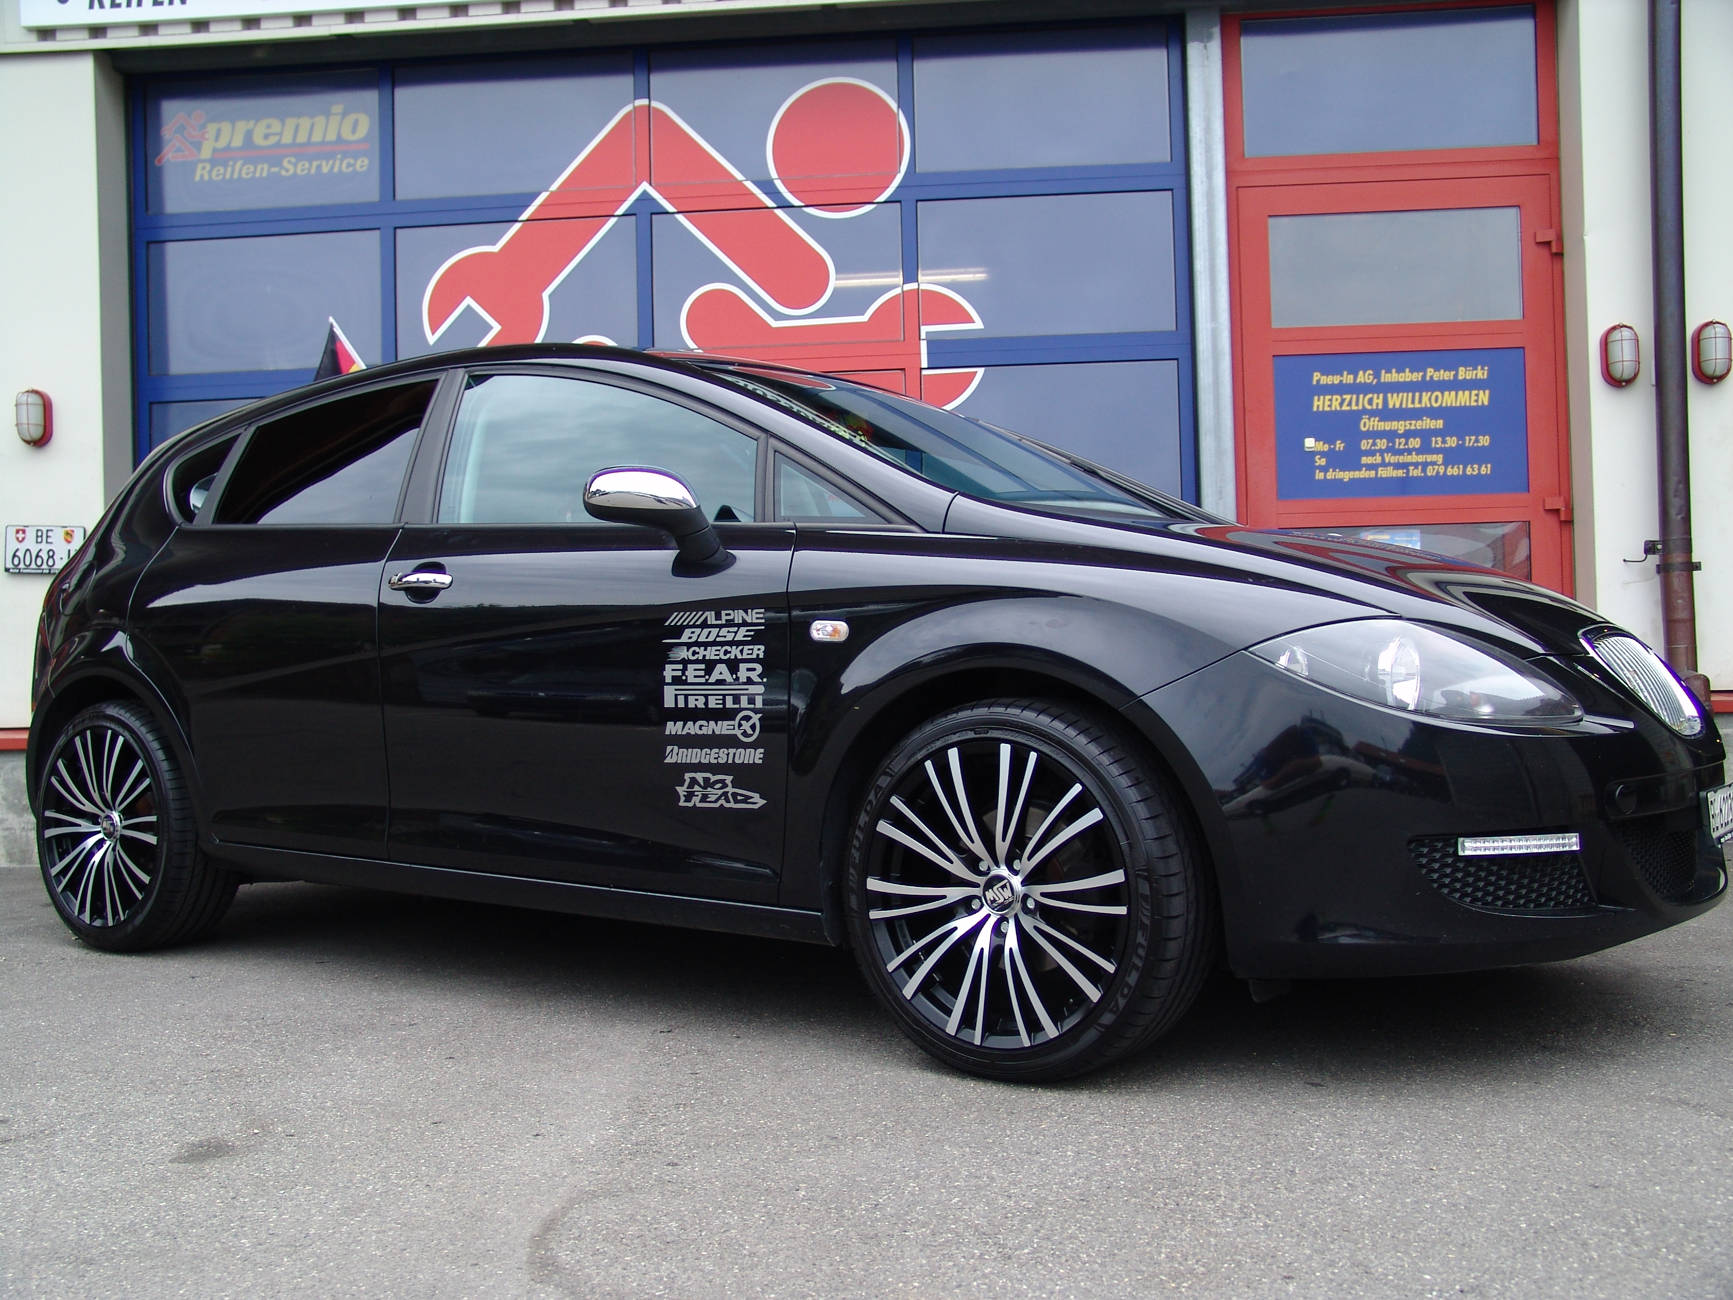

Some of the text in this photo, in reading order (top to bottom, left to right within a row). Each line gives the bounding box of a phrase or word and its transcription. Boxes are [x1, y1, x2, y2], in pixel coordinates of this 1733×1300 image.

[199, 104, 370, 159] premio
[194, 155, 370, 182] Reifen-Service
[1312, 365, 1488, 385] Pneu-In AG, Inhaber Peter Bürki
[1312, 389, 1490, 412] HERZLICH WILLKOMMEN
[1360, 415, 1444, 434] Öffnungszeiten
[1314, 440, 1329, 452] Mo
[1335, 440, 1345, 451] Fr
[1361, 438, 1387, 451] 07.30
[1395, 437, 1421, 449] 12.00
[1431, 436, 1457, 448] 13.30
[1465, 435, 1490, 447] 17.30
[1315, 452, 1443, 466] Sa nach Vereinbarung
[1315, 463, 1491, 482] In dringenden Fällen: Tel. 079 661 63 61
[35, 528, 54, 544] BE
[696, 608, 765, 626] ALPINE
[661, 626, 765, 643] BOSE
[687, 644, 765, 661] CHECKER
[664, 685, 765, 709] PIRELLI
[664, 746, 765, 764] BRIDGESTONE
[985, 879, 1013, 906] MSW
